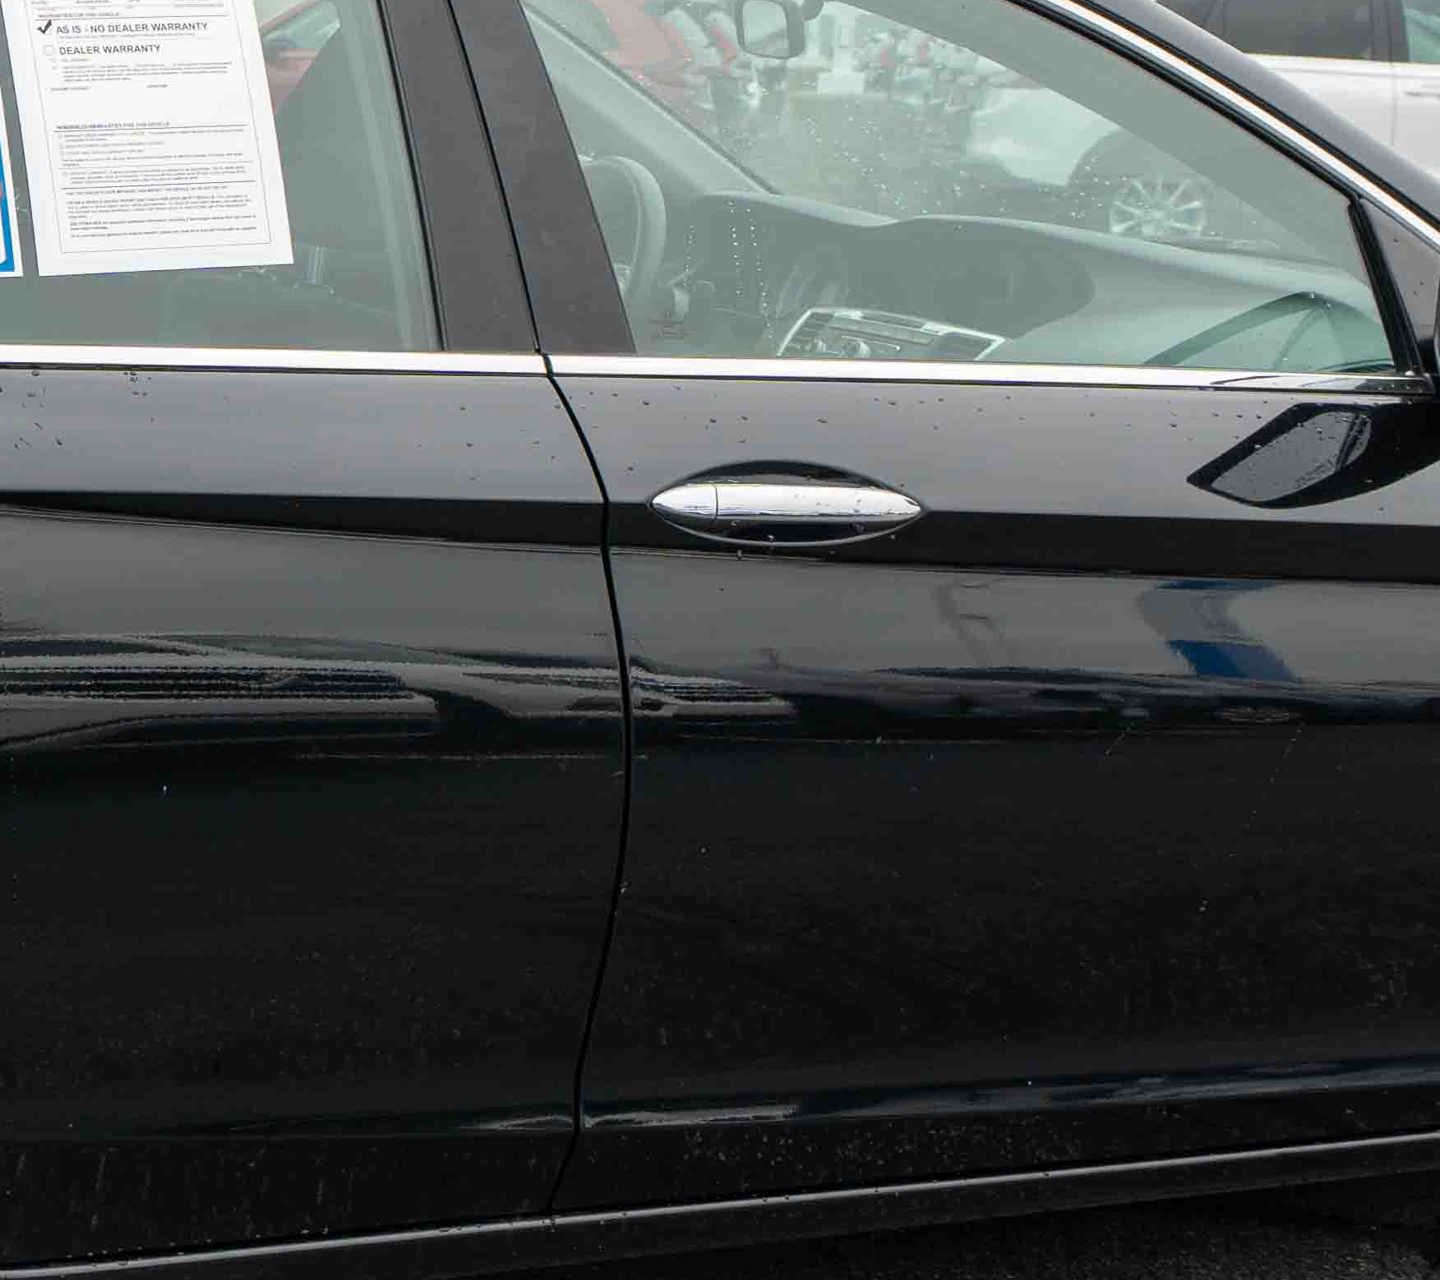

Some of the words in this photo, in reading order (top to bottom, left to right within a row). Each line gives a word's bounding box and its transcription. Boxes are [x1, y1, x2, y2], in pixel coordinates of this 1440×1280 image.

[56, 26, 70, 34] AS
[72, 25, 81, 34] IS
[90, 24, 105, 34] NO
[108, 24, 148, 33] DEALER
[150, 22, 208, 32] WARRANTY
[59, 46, 100, 56] DEALER
[103, 44, 161, 54] WARRANTY
